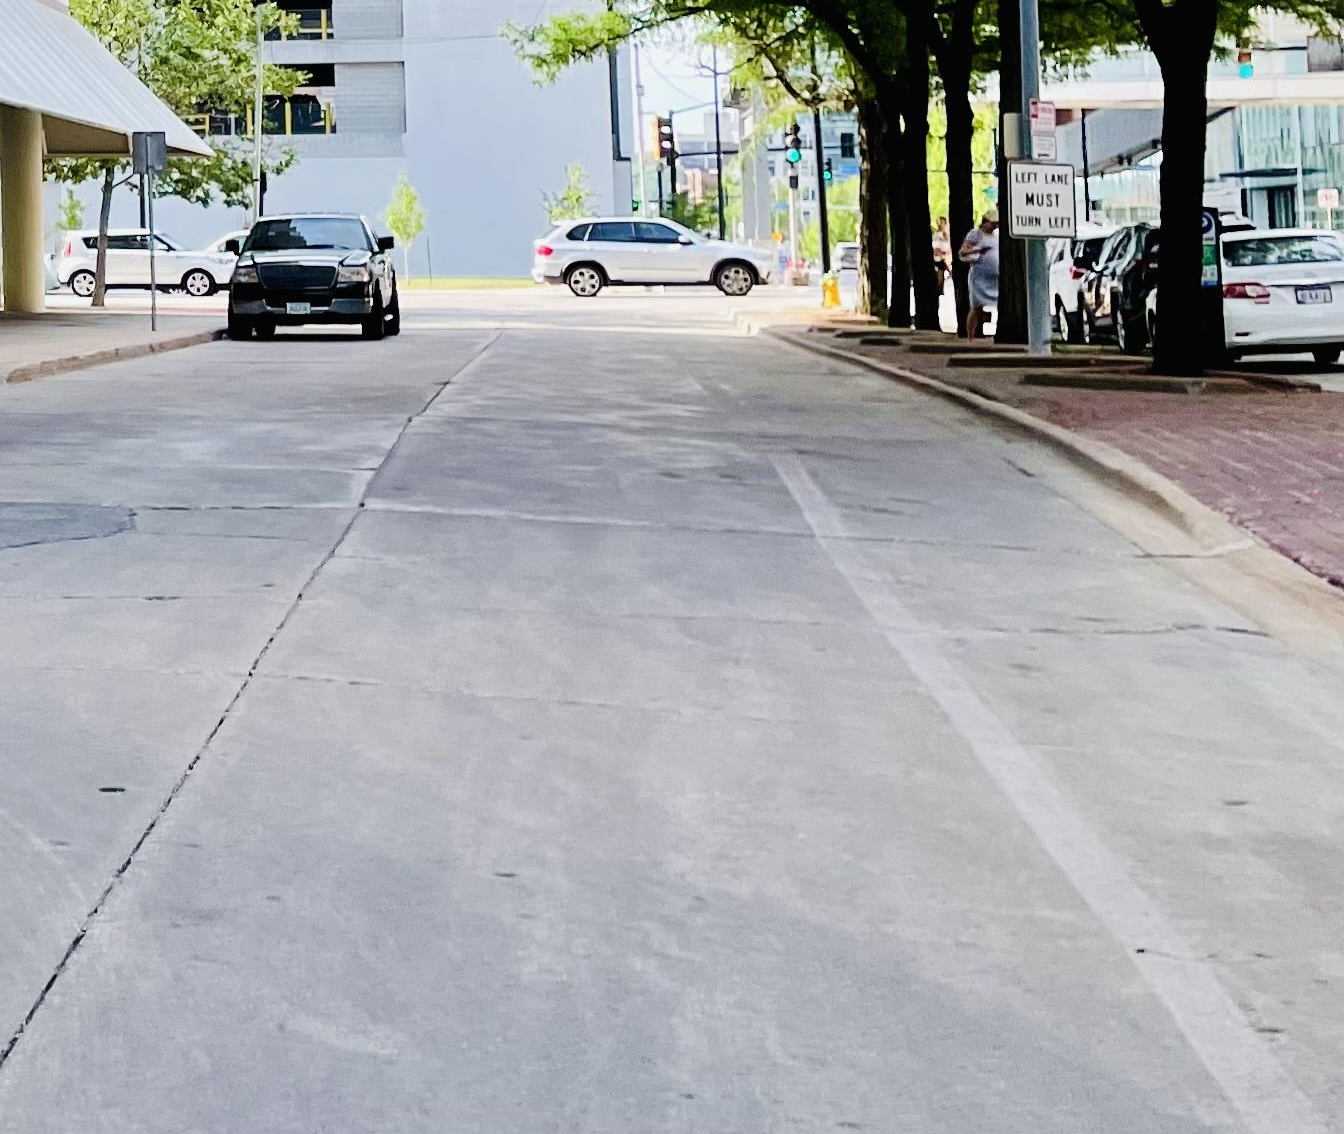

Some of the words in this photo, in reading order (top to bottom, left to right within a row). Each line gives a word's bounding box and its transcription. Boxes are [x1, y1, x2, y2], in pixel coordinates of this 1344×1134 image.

[1015, 172, 1038, 184] LEFT
[1044, 173, 1069, 186] LANE
[1025, 192, 1060, 208] MUST
[1015, 215, 1041, 227] TURN
[1048, 217, 1071, 229] LEFT
